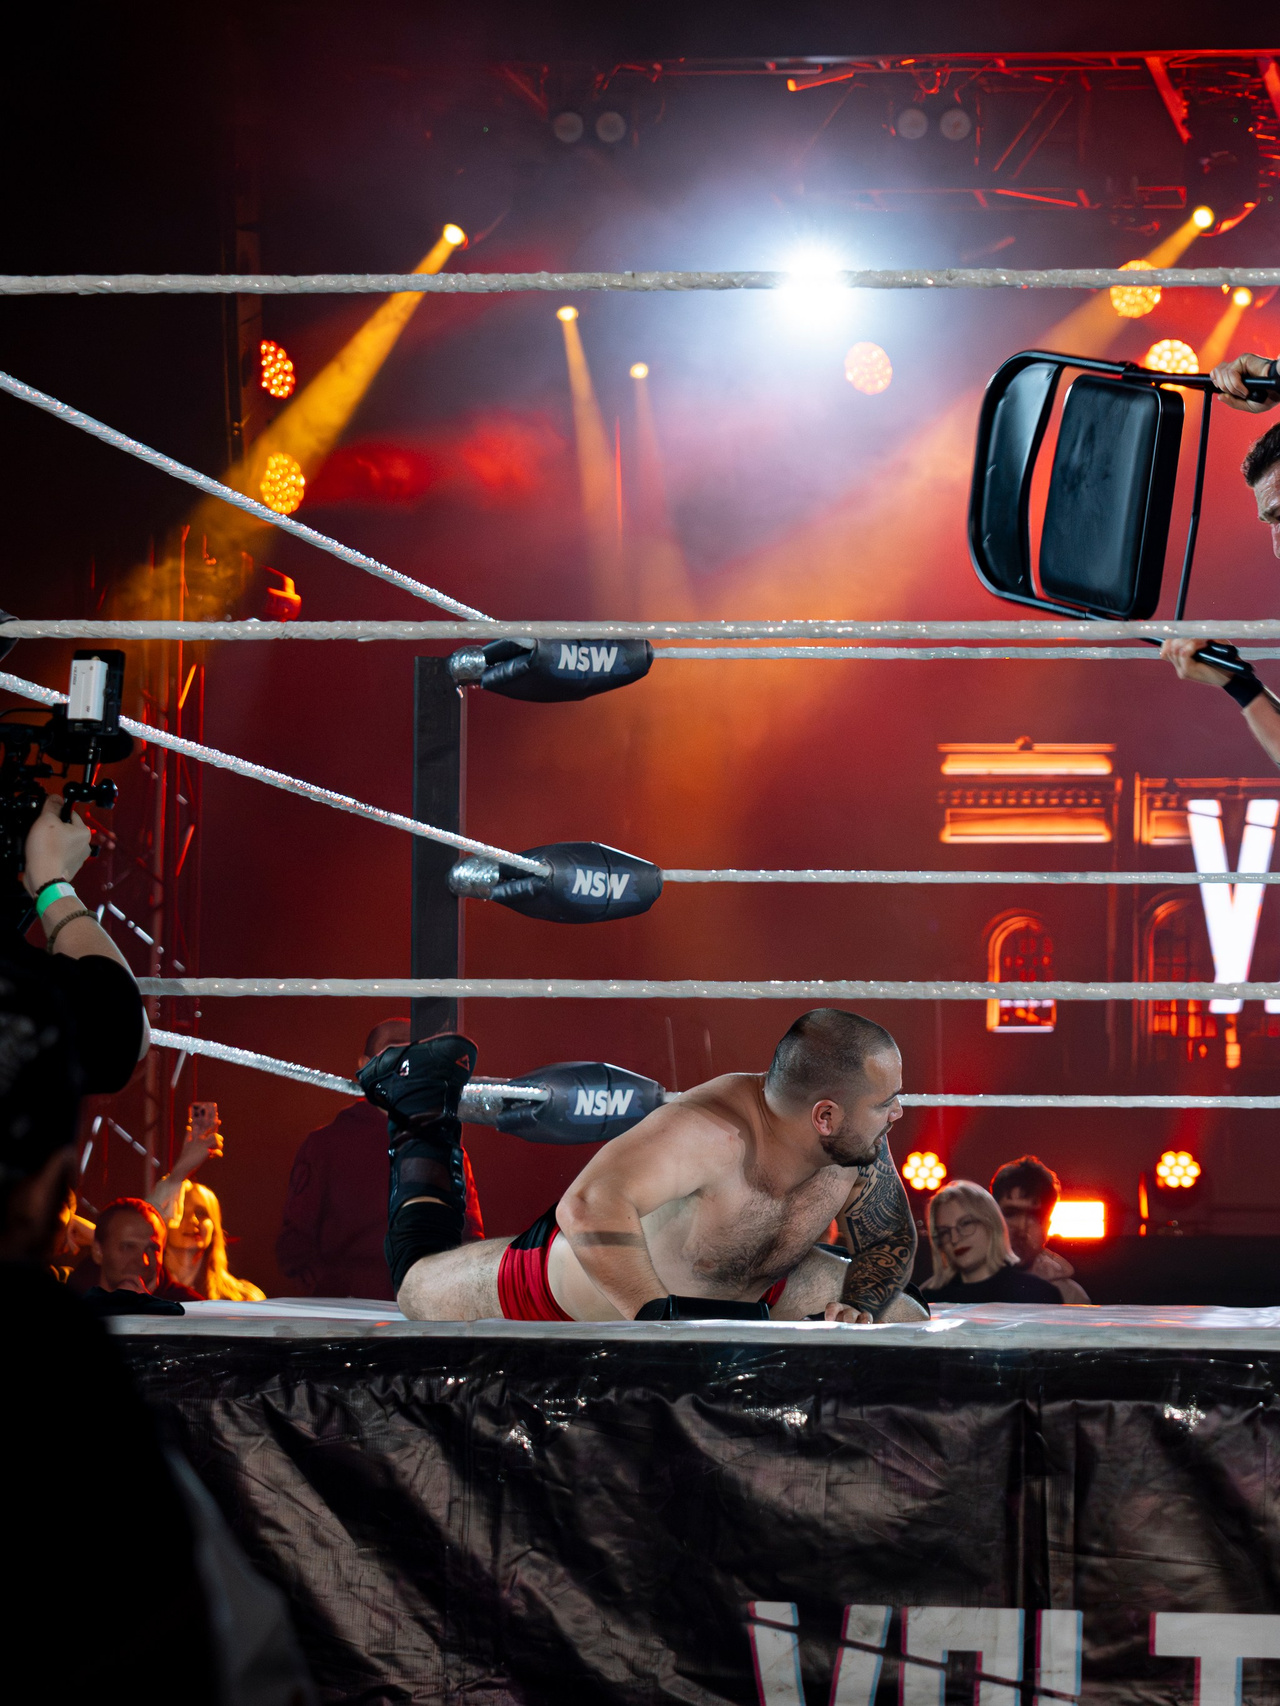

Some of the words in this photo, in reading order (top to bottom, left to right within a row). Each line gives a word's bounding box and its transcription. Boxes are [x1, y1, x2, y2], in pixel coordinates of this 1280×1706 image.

[559, 644, 618, 672] NSW
[573, 868, 630, 899] NSW
[574, 1089, 634, 1116] NSW
